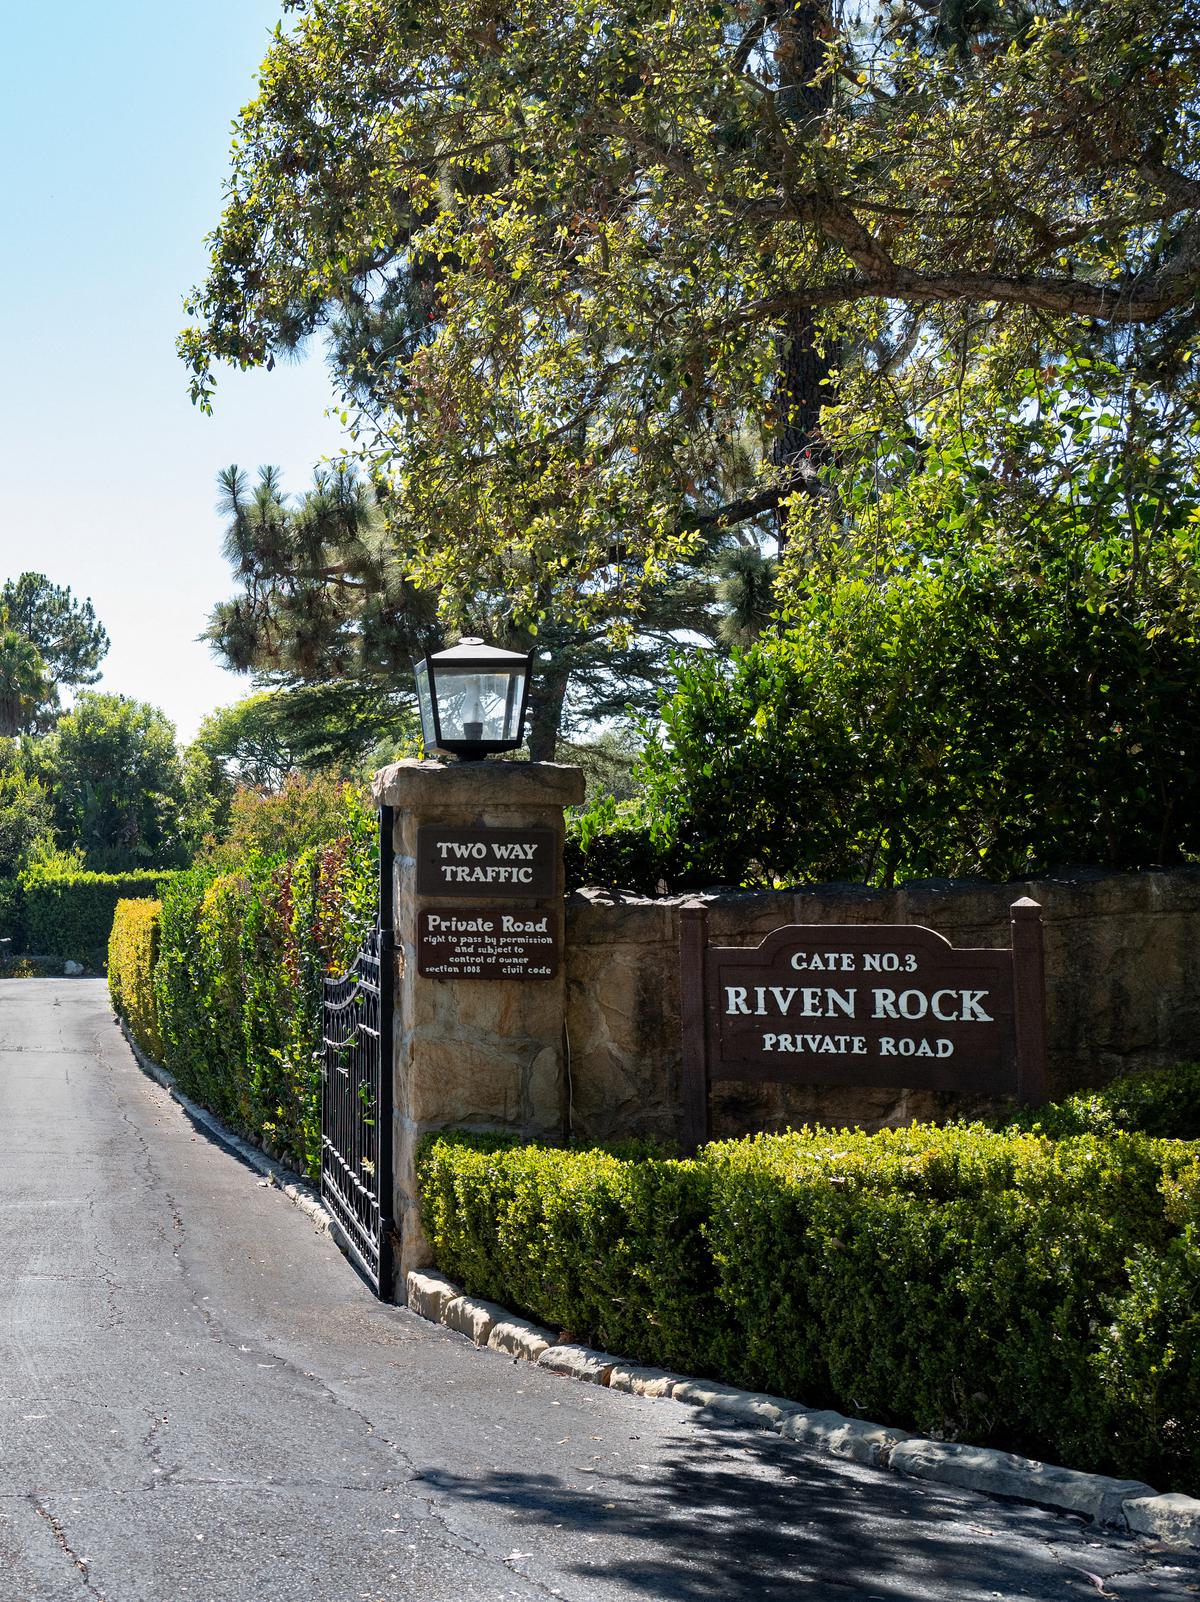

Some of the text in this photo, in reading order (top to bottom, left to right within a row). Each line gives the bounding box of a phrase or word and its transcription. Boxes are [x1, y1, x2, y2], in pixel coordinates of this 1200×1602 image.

[437, 842, 538, 859] TWO WAY
[441, 866, 532, 883] TRAFFIC
[427, 915, 547, 932] Private Road
[424, 935, 445, 945] right
[460, 937, 482, 945] pass
[485, 936, 496, 945] by
[500, 936, 552, 945] permission
[455, 945, 474, 953] and
[478, 945, 511, 954] subject
[502, 966, 523, 974] civil
[528, 966, 551, 974] code
[791, 953, 918, 972] GATE NO.3
[725, 987, 994, 1022] RIVEN ROCK
[763, 1033, 954, 1058] PRIVATE ROAD
